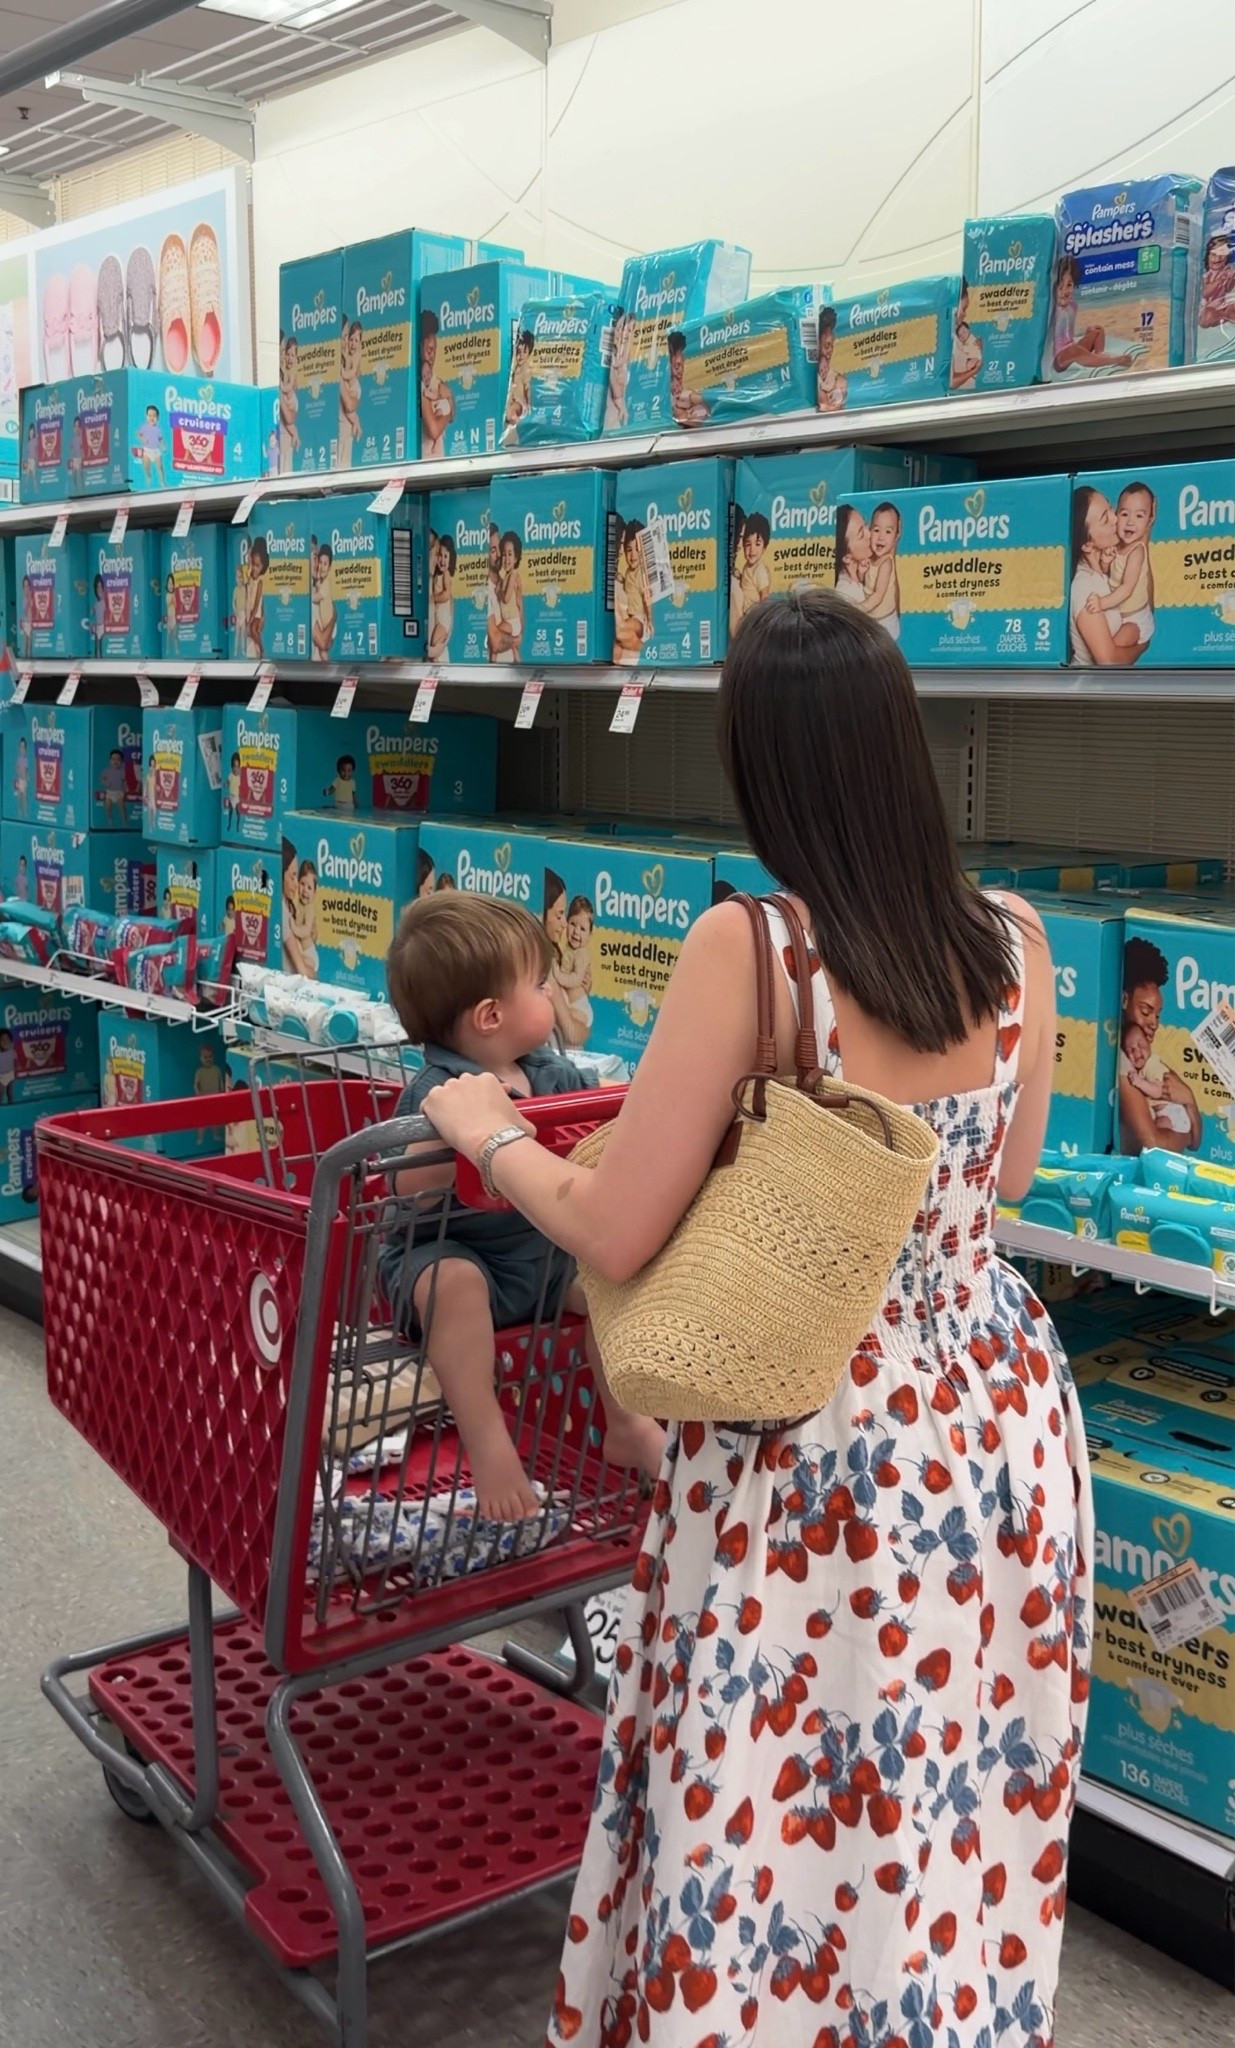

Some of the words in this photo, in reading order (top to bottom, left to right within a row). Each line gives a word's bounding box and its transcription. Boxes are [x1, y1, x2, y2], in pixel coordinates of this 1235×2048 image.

[1091, 201, 1135, 221] Pampers
[1065, 212, 1153, 252] splashers
[979, 251, 1036, 276] Pampers
[1085, 264, 1113, 276] contain
[1115, 260, 1135, 271] mess
[357, 287, 405, 316] Pampers
[635, 286, 687, 313] Pampers
[980, 286, 1029, 301] swaddlers
[292, 303, 337, 331] Pampers
[440, 301, 495, 331] Pampers
[849, 302, 901, 328] Pampers
[1141, 312, 1155, 326] 17
[534, 312, 588, 337] Pampers
[361, 331, 403, 350] swaddlers
[700, 320, 750, 348] Pampers
[853, 330, 897, 349] swaddlers
[443, 336, 491, 354] swaddlers
[533, 344, 580, 357] swaddlers
[704, 346, 748, 367] swaddlers
[924, 357, 935, 373] N
[780, 368, 790, 381] N
[989, 361, 999, 371] 27
[35, 399, 66, 420] Pampers
[77, 388, 113, 413] Pampers
[165, 385, 232, 421] Pampers
[652, 396, 660, 411] 2
[553, 405, 562, 418] 4
[178, 418, 222, 431] cruisers
[113, 428, 119, 440] 4
[383, 435, 390, 450] 2
[470, 428, 479, 443] N
[233, 442, 242, 456] 4
[319, 447, 326, 460] 2
[771, 496, 837, 533] Pamper
[524, 512, 581, 544] Pampers
[920, 505, 1010, 547] Pampers
[266, 529, 305, 555] Pampers
[332, 528, 374, 556] Pampers
[26, 551, 57, 575] Pampers
[99, 549, 134, 574] Pampers
[171, 551, 203, 572] Pampers
[268, 561, 303, 574] swaddlers
[528, 552, 577, 568] swaddlers
[784, 562, 802, 571] best
[923, 557, 1002, 578] swaddlers
[335, 562, 372, 577] swaddlers
[1183, 573, 1198, 581] our
[1199, 568, 1228, 580] best
[935, 578, 958, 589] best
[959, 578, 1001, 593] dryness
[941, 590, 971, 598] comfort
[972, 590, 986, 598] ever
[133, 594, 139, 607] 6
[203, 589, 209, 601] 6
[1004, 619, 1022, 633] 78
[1036, 618, 1051, 640] 3
[287, 632, 294, 646] 8
[357, 632, 364, 646] 7
[467, 633, 477, 644] 50
[536, 629, 547, 640] 58
[555, 628, 563, 646] 5
[645, 646, 657, 660] 66
[682, 632, 691, 651] 4
[1203, 631, 1223, 644] plus
[32, 717, 65, 744] Pampers
[237, 719, 280, 750] Pampers
[153, 730, 184, 755] Pampers
[366, 725, 439, 756] Pampers
[38, 747, 60, 758] cruisers
[67, 769, 74, 781] 4
[182, 778, 188, 789] 4
[390, 776, 412, 791] 360
[280, 778, 288, 794] 3
[454, 780, 463, 795] 3
[32, 835, 65, 866] Pampers
[317, 838, 382, 887] Pampers
[457, 849, 531, 900] Pampers
[595, 870, 690, 929] Pampers
[322, 897, 378, 922] swaddlers
[274, 924, 281, 939] 3
[331, 914, 347, 927] best
[349, 917, 378, 934] dryness
[613, 961, 635, 976] best
[619, 977, 647, 989] comfort
[649, 982, 665, 992] ever
[5, 1004, 72, 1029] Pampers
[19, 1025, 62, 1038] cruisers
[109, 1036, 146, 1064] Pampers
[1183, 1070, 1199, 1080] our
[1, 1127, 23, 1197] Pampers
[1210, 1145, 1234, 1161] plus
[1120, 1207, 1151, 1224] Pampers
[1104, 1628, 1146, 1658] best
[1117, 1653, 1168, 1682] comfort
[1170, 1676, 1200, 1695] ever
[1118, 1721, 1145, 1745] plus
[1147, 1730, 1195, 1765] sèches
[1120, 1760, 1151, 1788] 136
